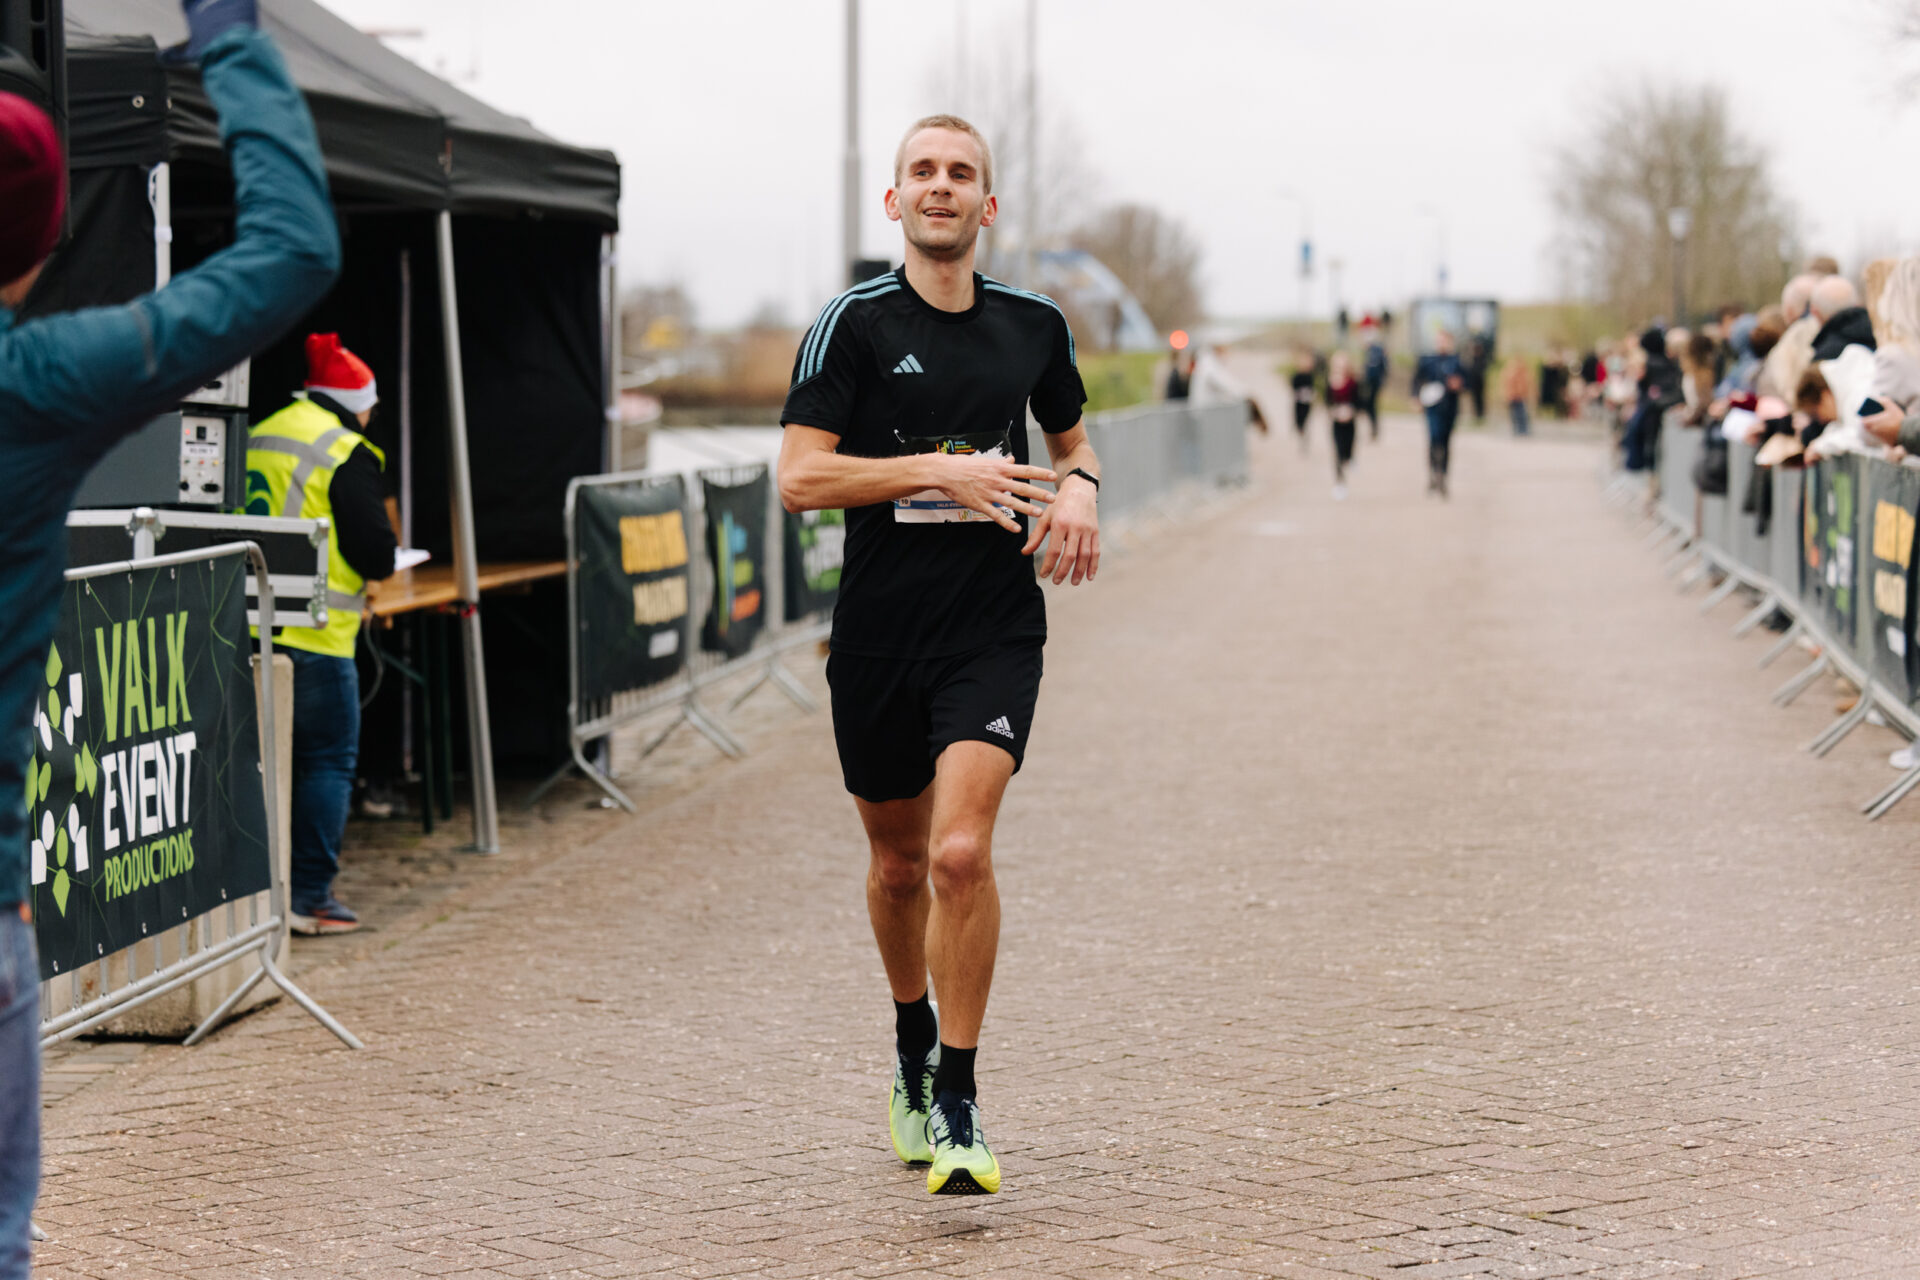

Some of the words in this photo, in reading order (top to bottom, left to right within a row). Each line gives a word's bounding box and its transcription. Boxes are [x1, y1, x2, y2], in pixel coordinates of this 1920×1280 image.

[95, 611, 192, 743] VALK
[986, 724, 1015, 739] adidas
[101, 731, 197, 851] EVENT
[104, 828, 195, 902] PRODUCTIONS
